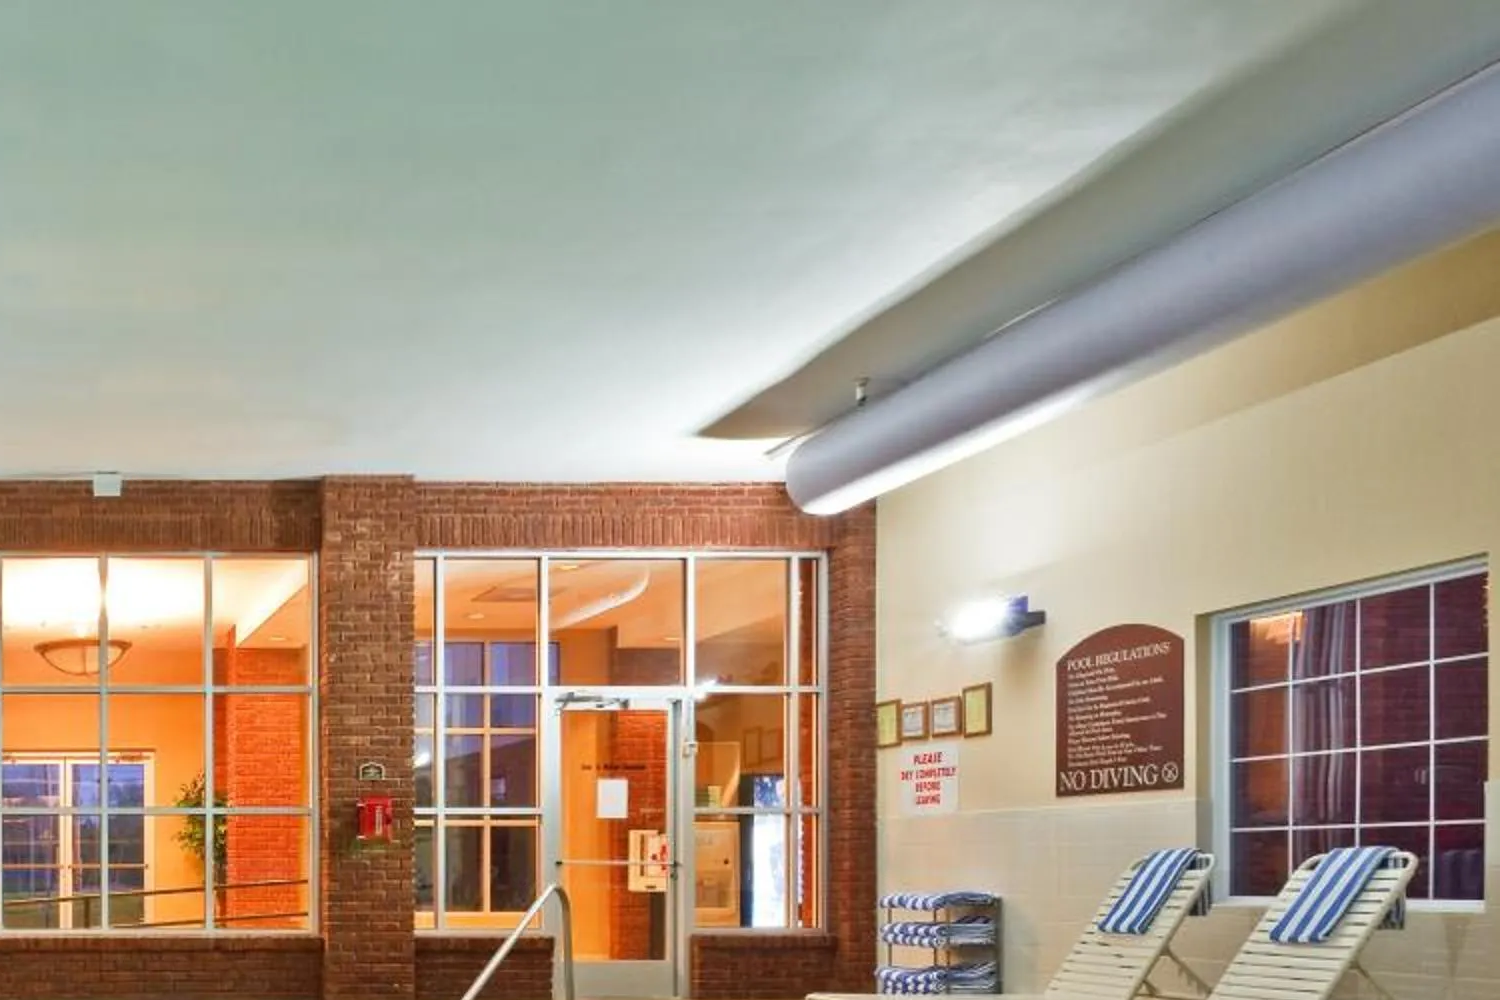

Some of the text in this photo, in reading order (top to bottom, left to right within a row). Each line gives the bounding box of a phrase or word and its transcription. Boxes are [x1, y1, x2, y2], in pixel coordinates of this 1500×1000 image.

[1067, 641, 1172, 671] POOL REGULATIONS
[913, 752, 942, 765] PLEASE
[1059, 763, 1159, 792] NO DIVING
